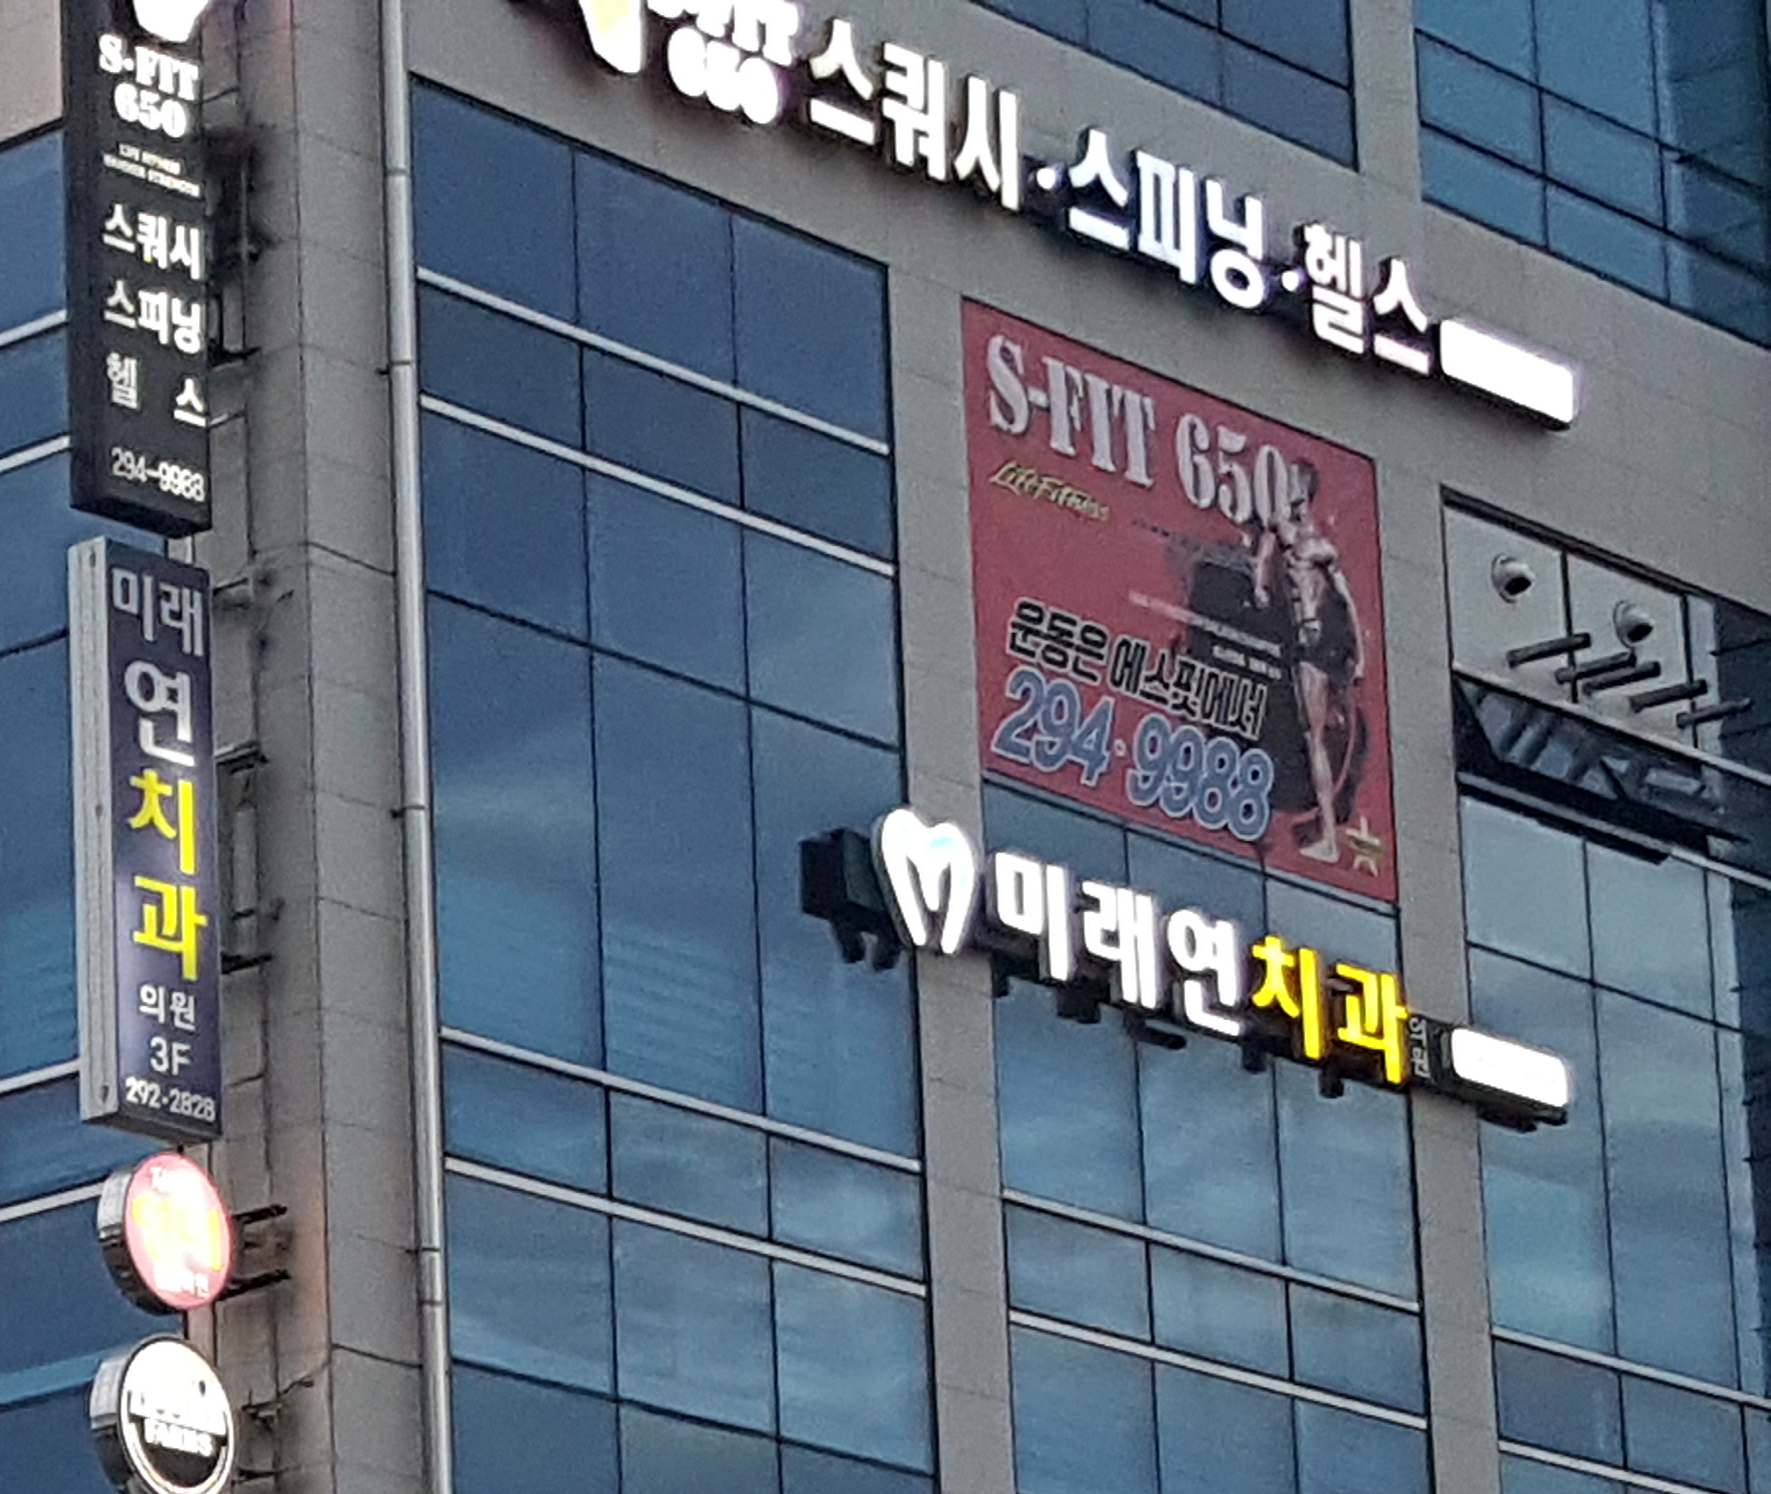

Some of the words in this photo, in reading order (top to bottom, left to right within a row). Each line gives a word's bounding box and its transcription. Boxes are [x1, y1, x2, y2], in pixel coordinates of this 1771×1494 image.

[113, 82, 188, 139] 650
[102, 203, 203, 281] 스쿼시
[103, 280, 204, 354] 스피닝
[986, 334, 1157, 488] S-FIT
[1174, 412, 1289, 526] 650
[140, 984, 197, 1030] 의원
[150, 1037, 192, 1076] 3F
[124, 1077, 216, 1122] 292-2828
